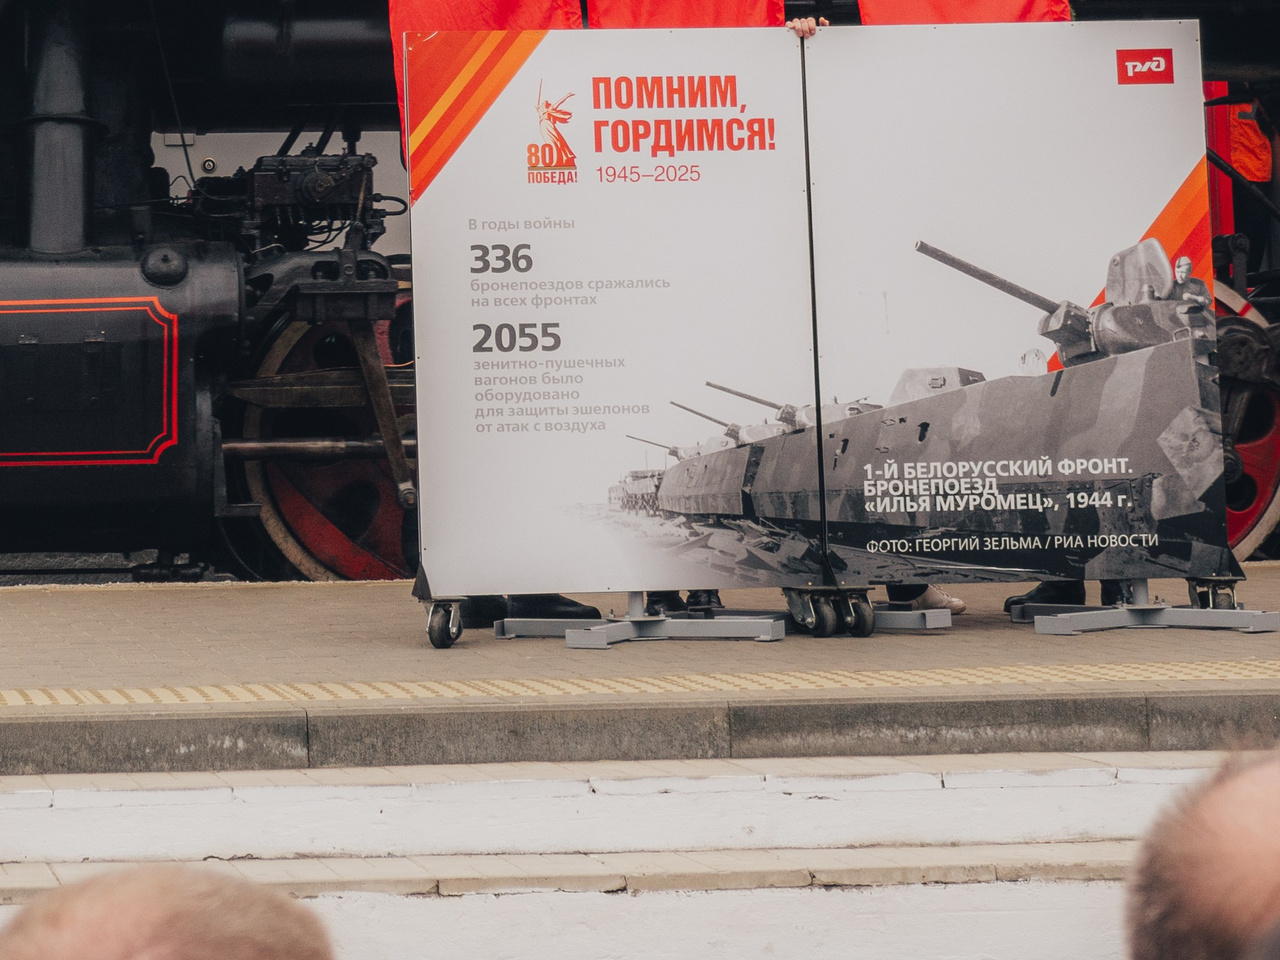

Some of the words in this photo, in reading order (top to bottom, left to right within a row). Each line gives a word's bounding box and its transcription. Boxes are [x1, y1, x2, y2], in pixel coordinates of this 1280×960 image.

[592, 75, 747, 113] ПОМНИМ,
[593, 118, 776, 157] ГОРДИМСЯ!
[527, 143, 554, 167] 80
[527, 171, 578, 185] ПОБЕДА!
[468, 219, 477, 230] В
[481, 220, 519, 231] годы
[523, 217, 575, 230] войны
[470, 244, 533, 273] 336
[470, 279, 584, 294] бронепоездов
[587, 278, 671, 292] сражались
[471, 297, 489, 307] на
[493, 296, 527, 307] всех
[531, 294, 597, 309] фронтах
[472, 323, 561, 352] 2055
[473, 357, 626, 372] зенитно-пушечных
[474, 375, 537, 386] вагонов
[541, 372, 583, 385] было
[474, 389, 580, 404] оборудовано
[475, 407, 504, 419] для
[508, 406, 569, 418] защиты
[572, 404, 650, 416] эшелонов
[476, 423, 492, 433] от
[496, 422, 529, 432] атак
[533, 422, 541, 432] с
[544, 421, 606, 433] воздуха
[863, 458, 898, 479] 1-Й
[903, 455, 1053, 479] БЕЛОРУССКИЙ
[1057, 457, 1133, 476] ФРОНТ.
[863, 478, 998, 497] БРОНЕПОЕЗД
[864, 496, 931, 513] «ИЛЬЯ
[936, 493, 1059, 512] МУРОМЕЦ»,
[1066, 492, 1113, 509] 1944
[1117, 495, 1133, 507] г.
[866, 539, 912, 554] ФОТО:
[915, 537, 980, 552] ГЕОРГИЙ
[983, 537, 1042, 551] ЗЕЛЬМА
[1054, 535, 1085, 549] РИА
[1088, 534, 1159, 548] НОВОСТИ
